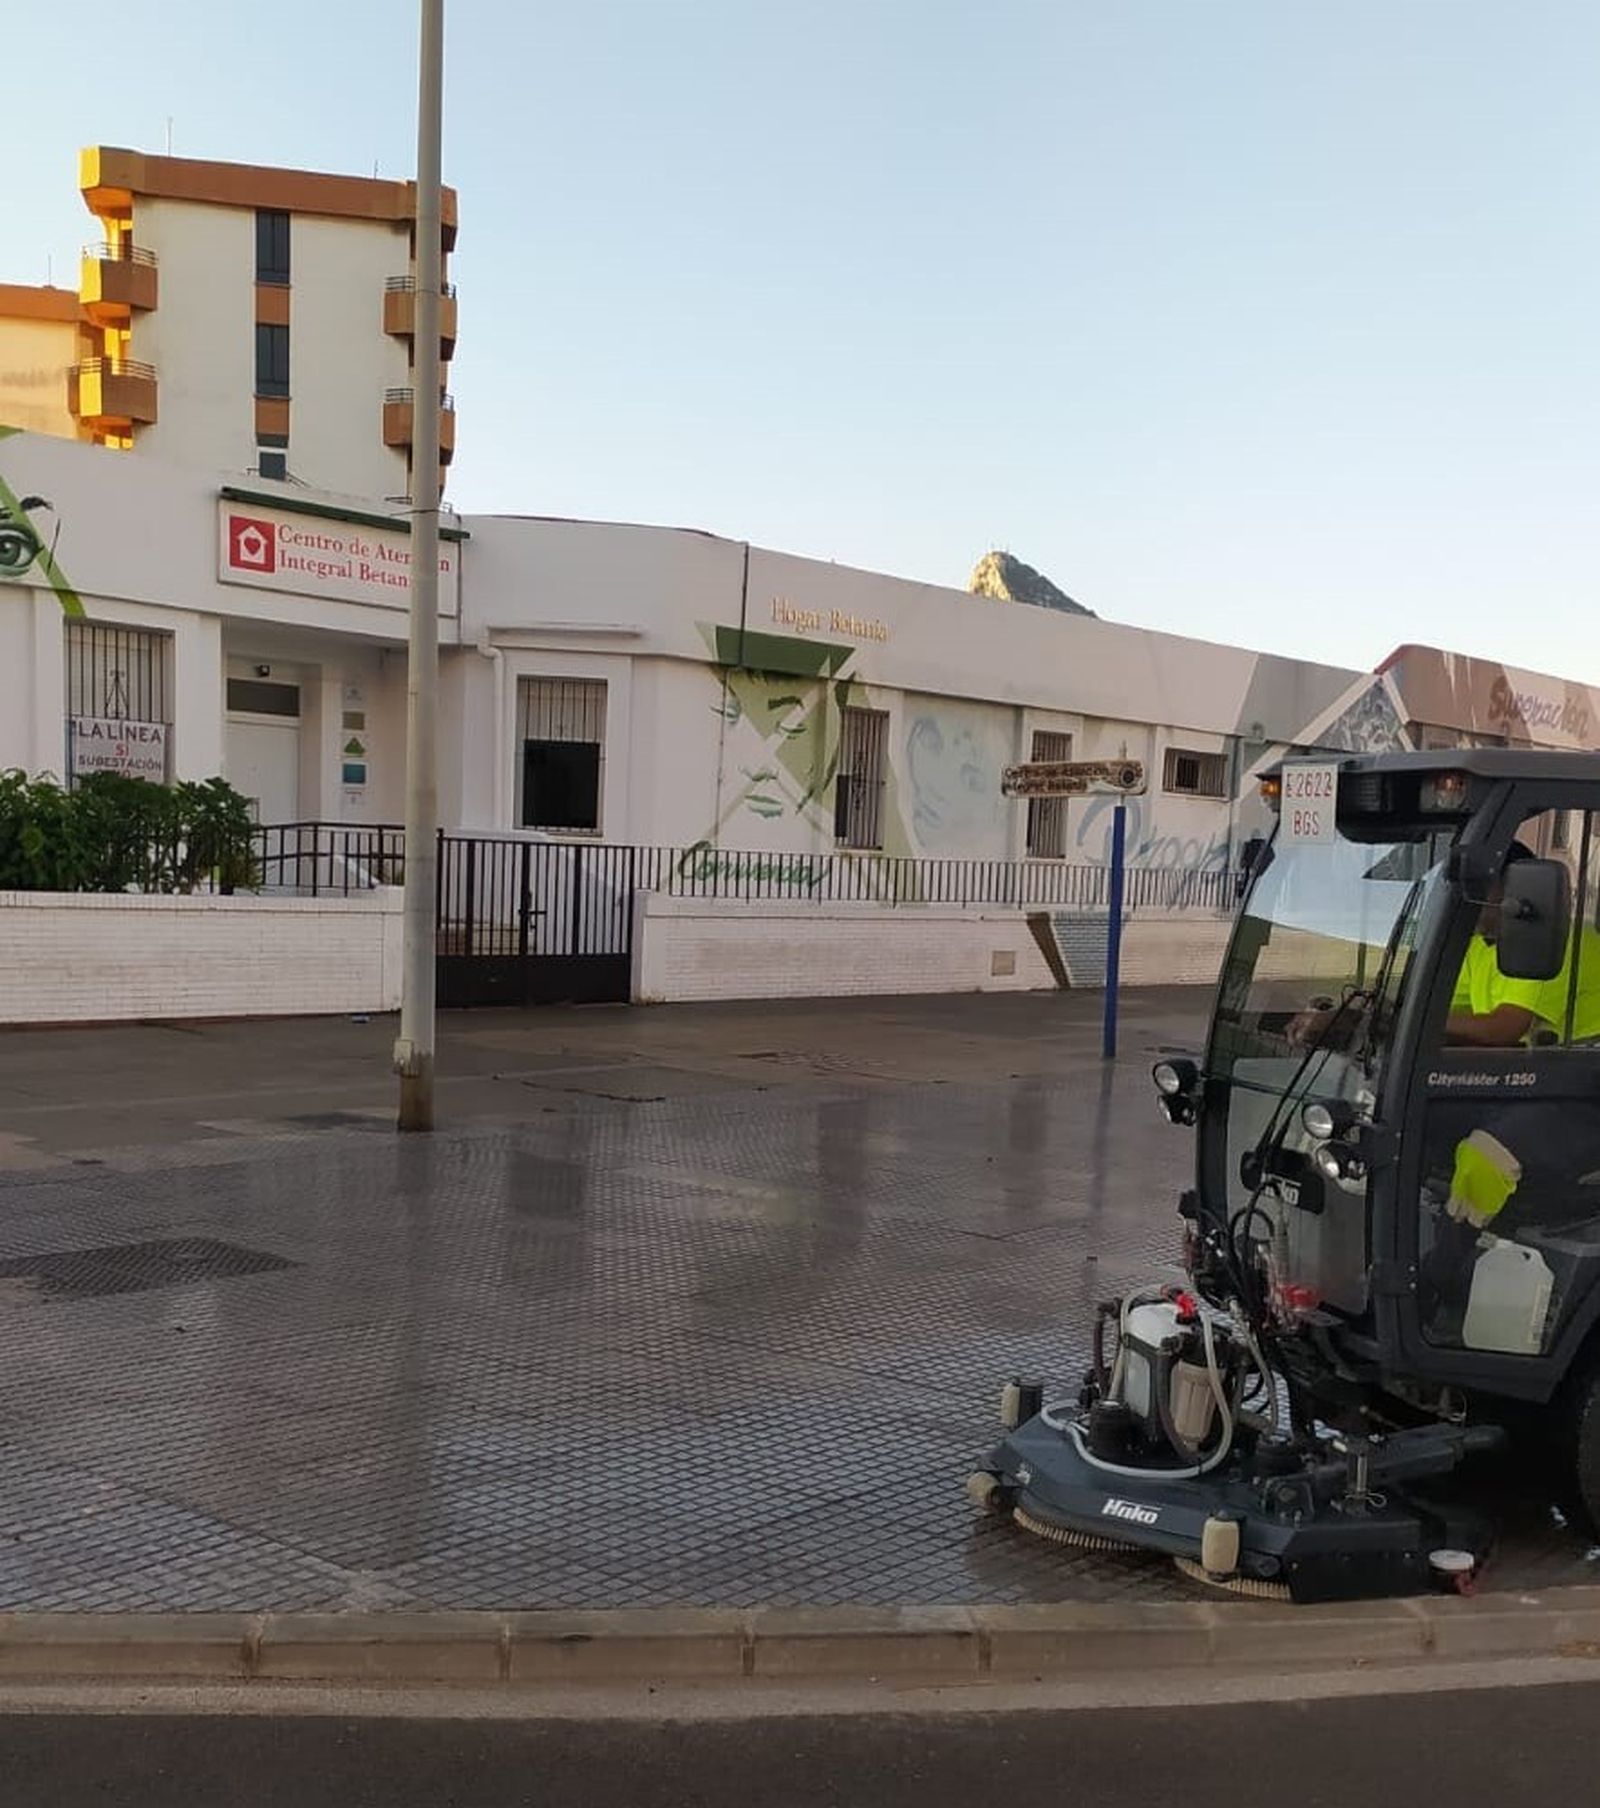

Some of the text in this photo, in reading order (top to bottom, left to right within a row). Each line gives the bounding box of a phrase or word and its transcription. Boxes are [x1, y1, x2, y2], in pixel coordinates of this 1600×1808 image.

[278, 524, 450, 572] Centro de Atenn
[280, 550, 410, 588] Integral Betan
[770, 597, 890, 643] Hogar Betania
[78, 721, 103, 739] LA
[1293, 809, 1320, 836] BGS
[1427, 1070, 1537, 1088] Citymaster 1250
[1101, 1498, 1161, 1525] Hako
